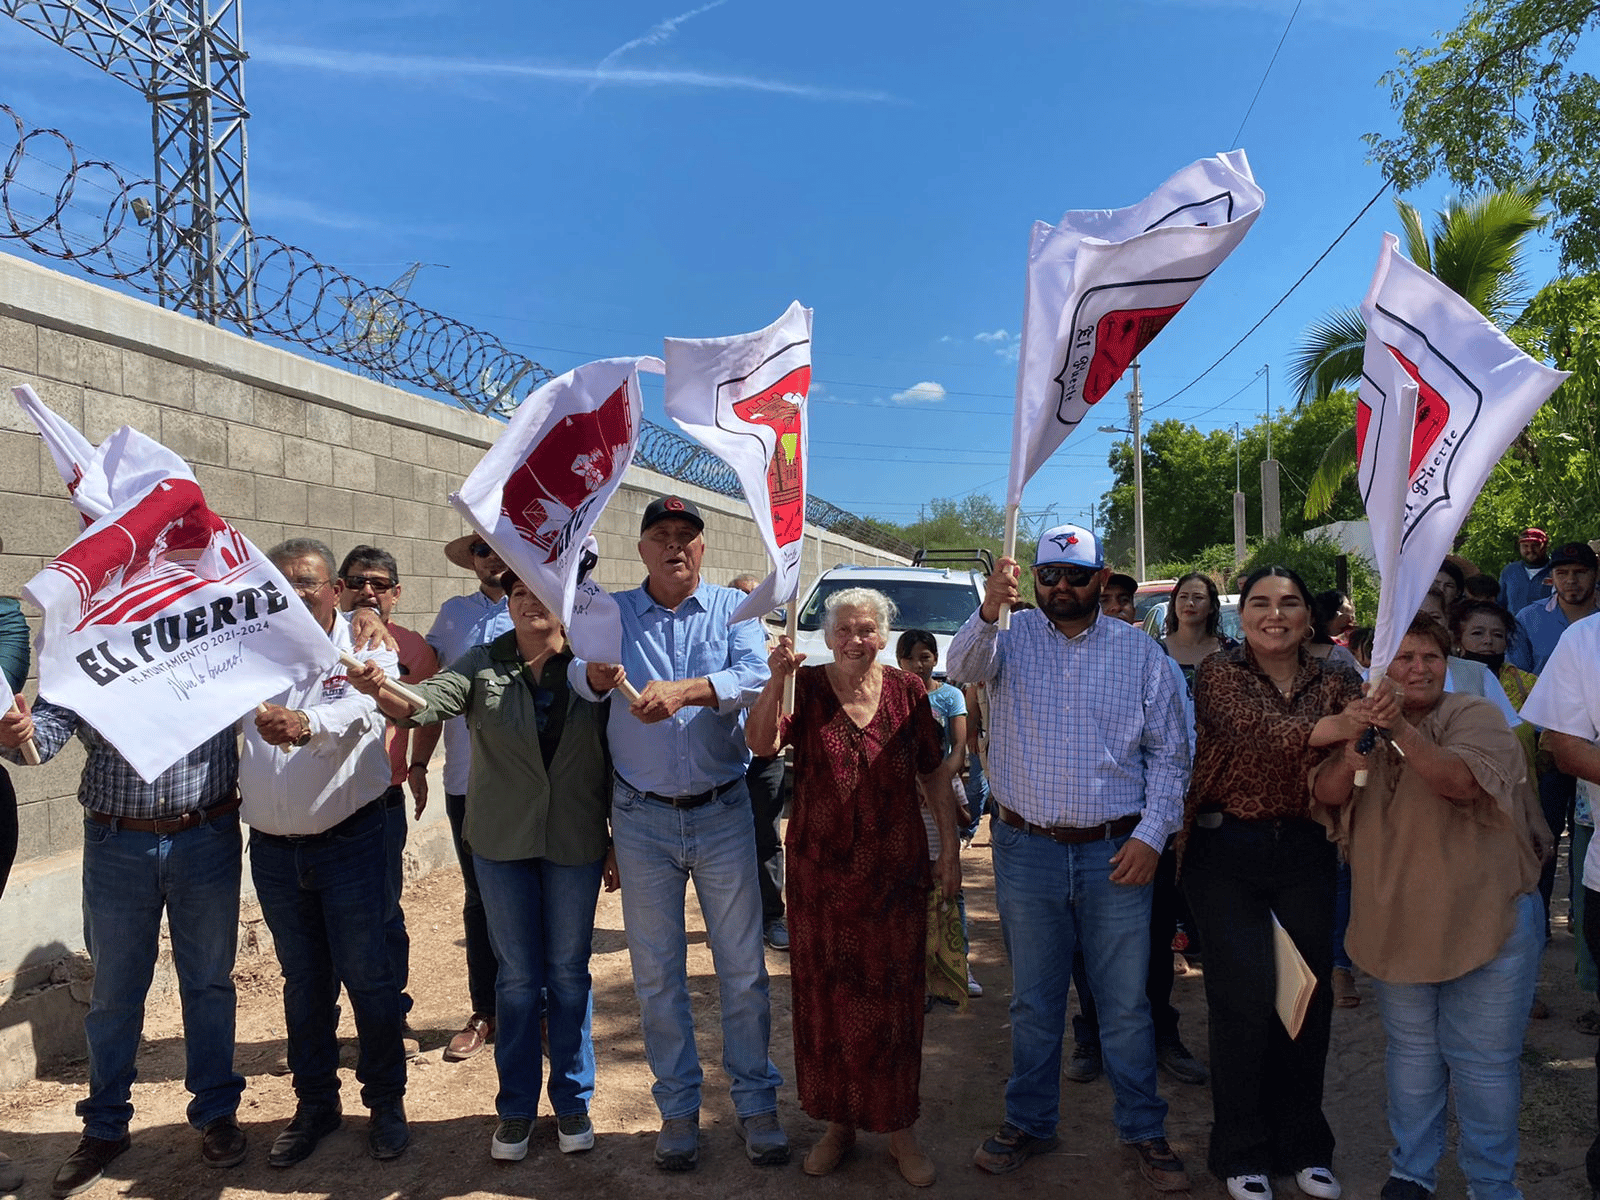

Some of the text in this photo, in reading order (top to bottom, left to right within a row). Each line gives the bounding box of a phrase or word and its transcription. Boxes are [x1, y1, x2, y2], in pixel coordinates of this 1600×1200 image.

[1412, 430, 1457, 496] Fuerte
[76, 580, 288, 687] EL FUERTE
[128, 620, 270, 685] H. AYUNTAMIENTO 2021-2024
